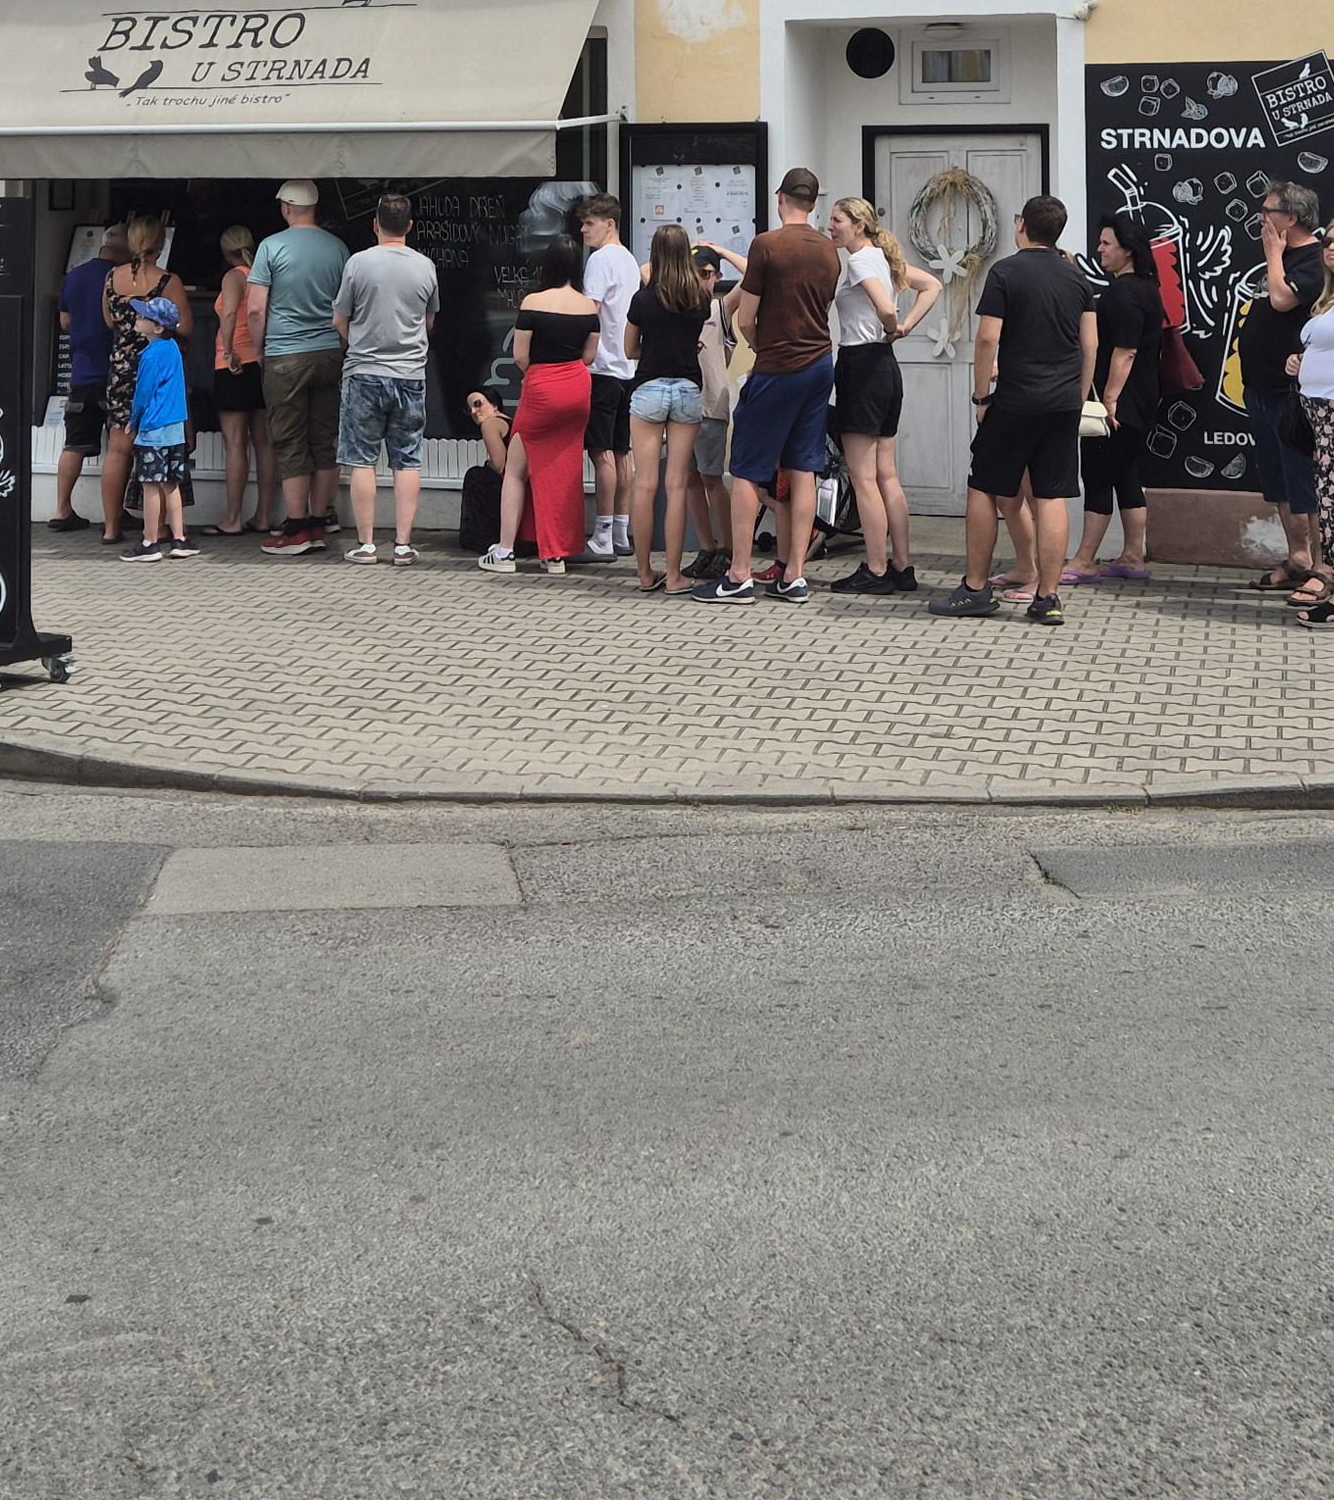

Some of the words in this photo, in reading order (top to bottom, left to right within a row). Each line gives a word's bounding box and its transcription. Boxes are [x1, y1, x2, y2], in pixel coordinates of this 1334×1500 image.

[97, 11, 307, 52] BISTRO
[190, 61, 216, 83] U
[220, 57, 372, 83] STRNADA
[163, 96, 208, 106] trochu
[209, 94, 237, 107] jiné
[1265, 76, 1327, 109] BISTRO
[1272, 110, 1281, 121] U
[1282, 91, 1333, 117] STRNADA
[1100, 126, 1266, 150] STRNADOVA
